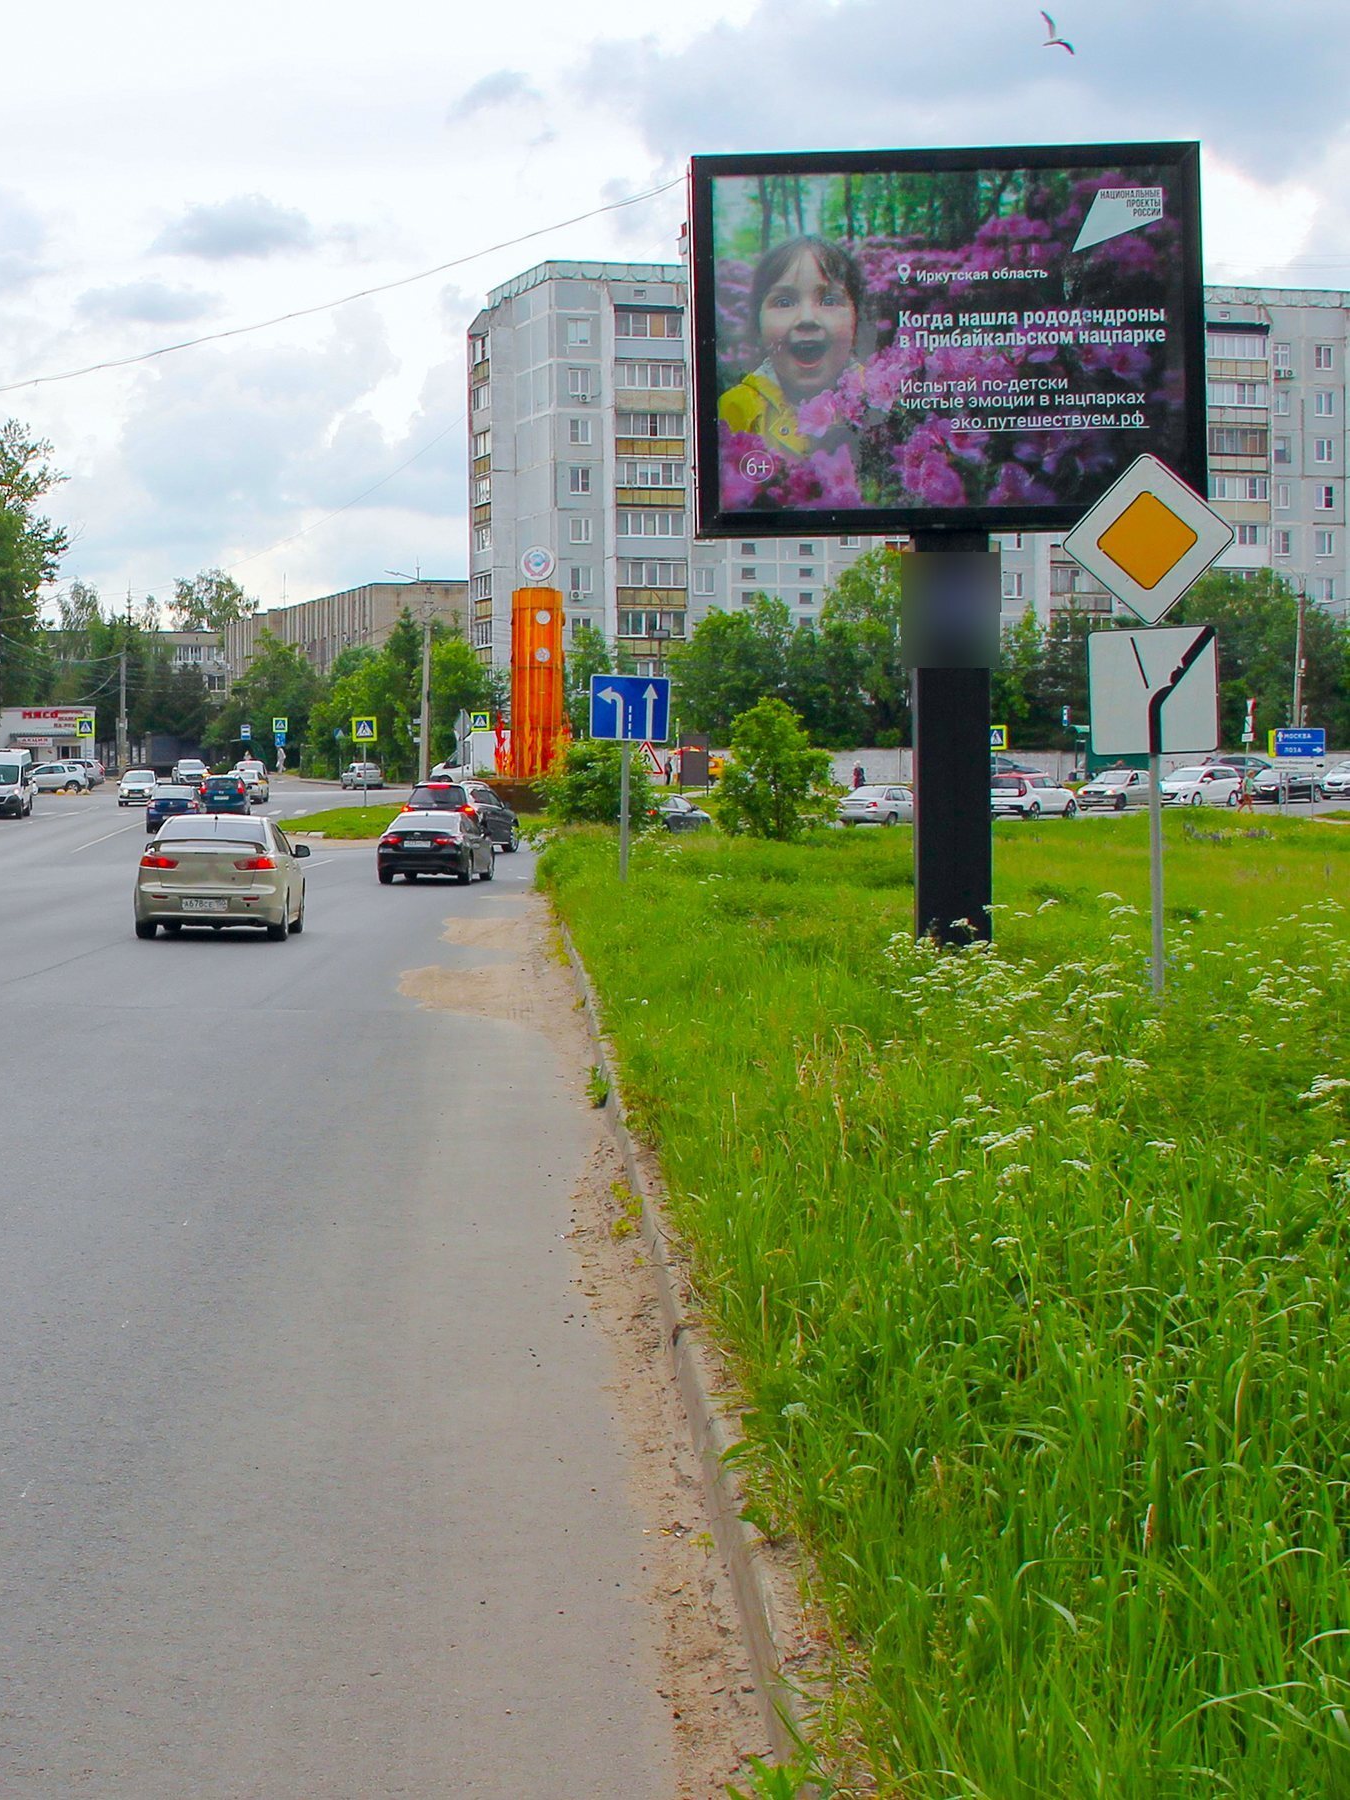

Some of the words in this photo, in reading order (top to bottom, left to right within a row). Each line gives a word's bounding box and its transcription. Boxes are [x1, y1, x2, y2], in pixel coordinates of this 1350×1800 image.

[1100, 189, 1161, 199] НАЦИОНАЛЬНЫЕ
[1126, 198, 1161, 208] ПРОЕКТЫ
[1132, 207, 1161, 217] РОССИИ
[916, 269, 989, 284] Иркутская
[992, 267, 1048, 280] область
[898, 310, 953, 330] Когда
[958, 311, 1018, 326] нашла
[1023, 308, 1165, 329] рододендроны
[899, 334, 910, 348] в
[915, 328, 1073, 352] Прибайкальском
[1078, 328, 1166, 347] нацпарке
[900, 376, 977, 393] Испытай
[982, 378, 1068, 393] по-детски
[900, 396, 964, 409] чистые
[968, 393, 1034, 409] эмоции
[1039, 394, 1050, 406] в
[1054, 392, 1146, 408] нацпарках
[951, 410, 1145, 431] эко.путешествуем.рф
[746, 457, 770, 476] 6+
